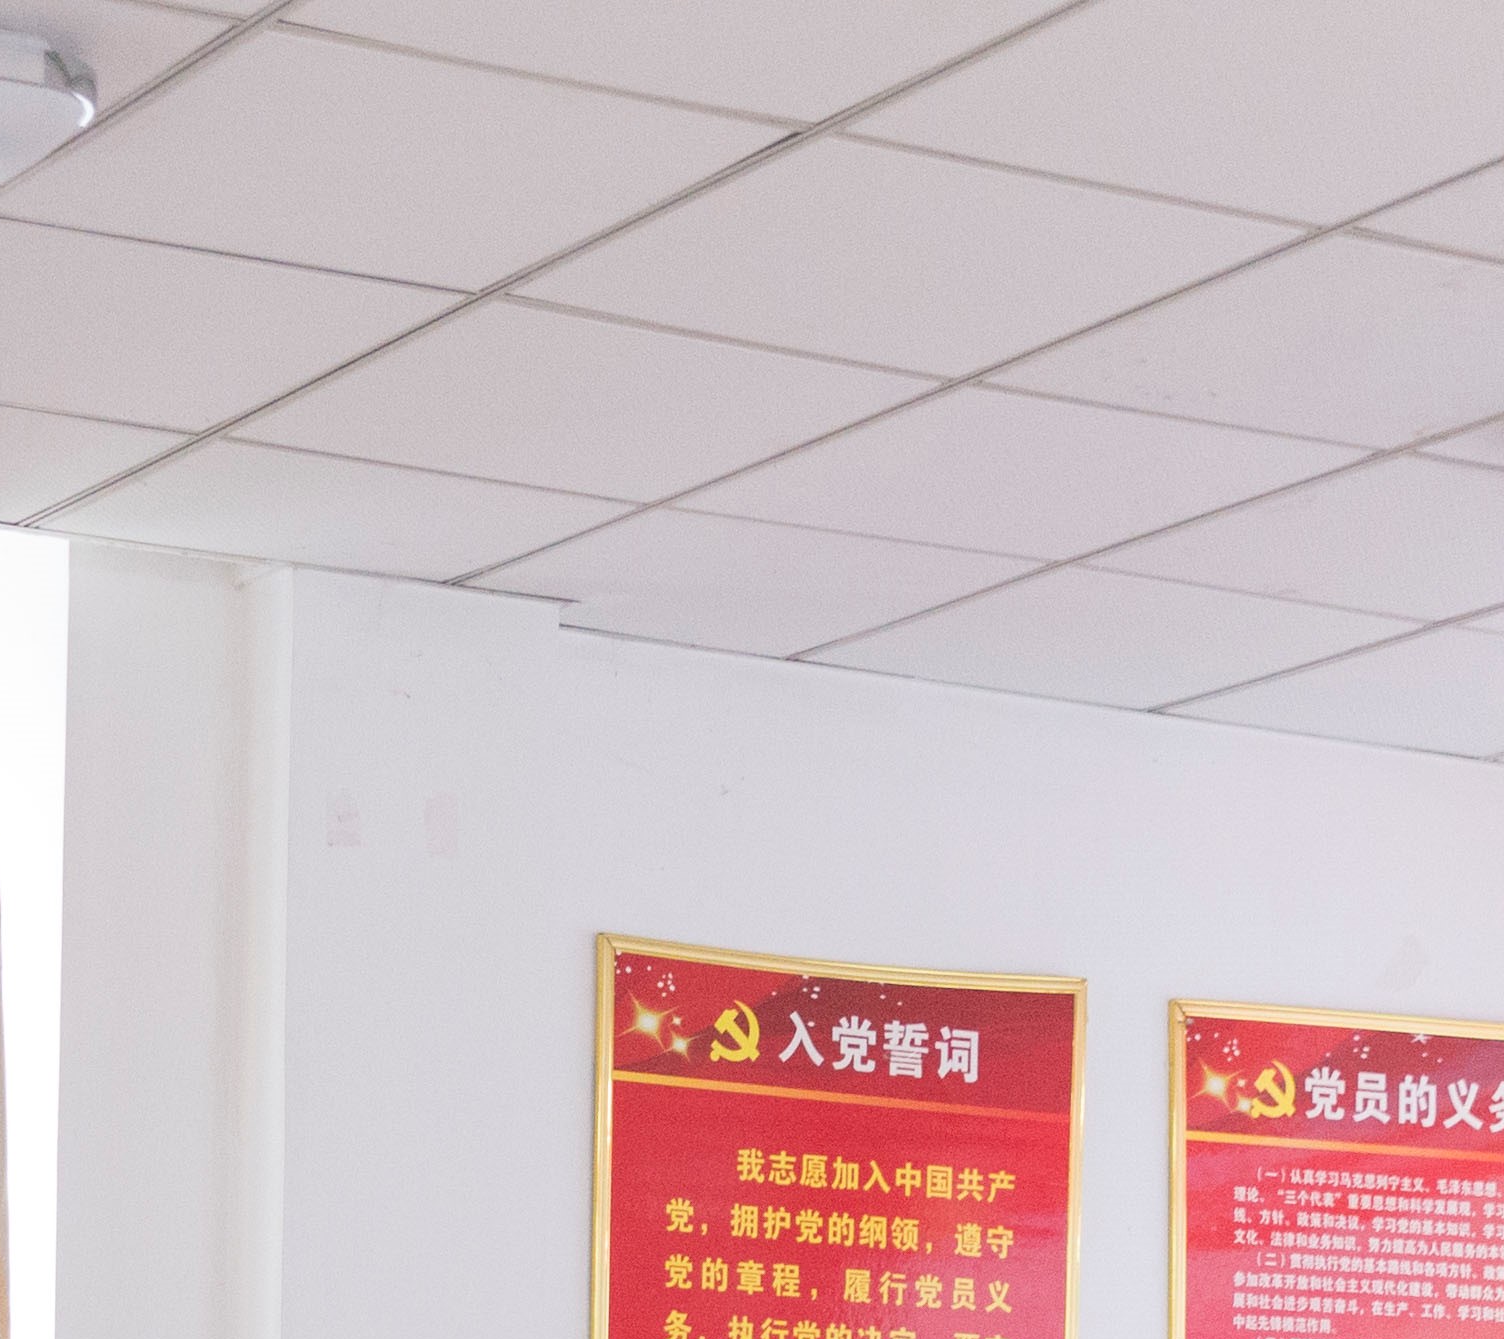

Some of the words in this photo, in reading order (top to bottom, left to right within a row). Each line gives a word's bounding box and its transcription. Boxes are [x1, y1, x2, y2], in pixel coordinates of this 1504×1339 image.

[778, 1010, 980, 1084] 入党誓词
[736, 1147, 1016, 1203] 我志愿加入中国共产
[664, 1197, 1015, 1260] 党，拥护党的纲领，遵守
[663, 1253, 1013, 1314] 党的章程，履行党员义
